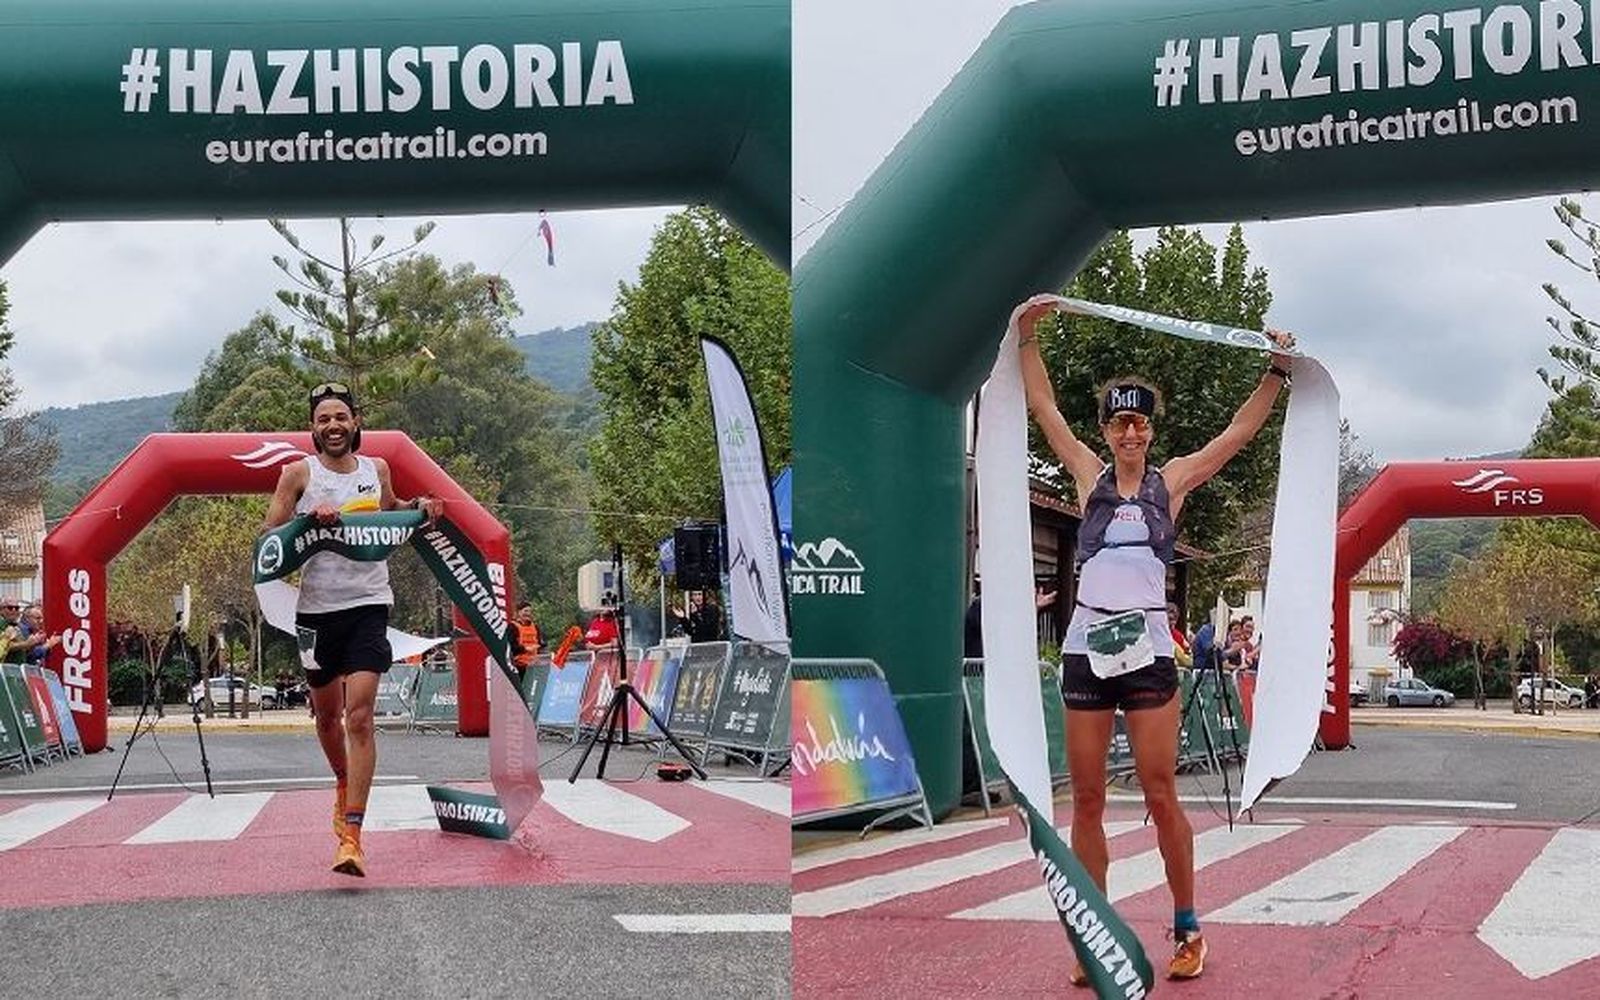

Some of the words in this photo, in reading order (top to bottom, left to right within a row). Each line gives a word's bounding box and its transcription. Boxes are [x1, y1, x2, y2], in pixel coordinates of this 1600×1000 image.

[120, 40, 635, 115] #HAZHISTORIA
[205, 127, 548, 165] eurafricatrail.com
[1235, 96, 1578, 156] eurafricatrail.com
[1494, 488, 1543, 506] FRS
[819, 575, 865, 594] TRAIL
[63, 569, 92, 714] FRS.es
